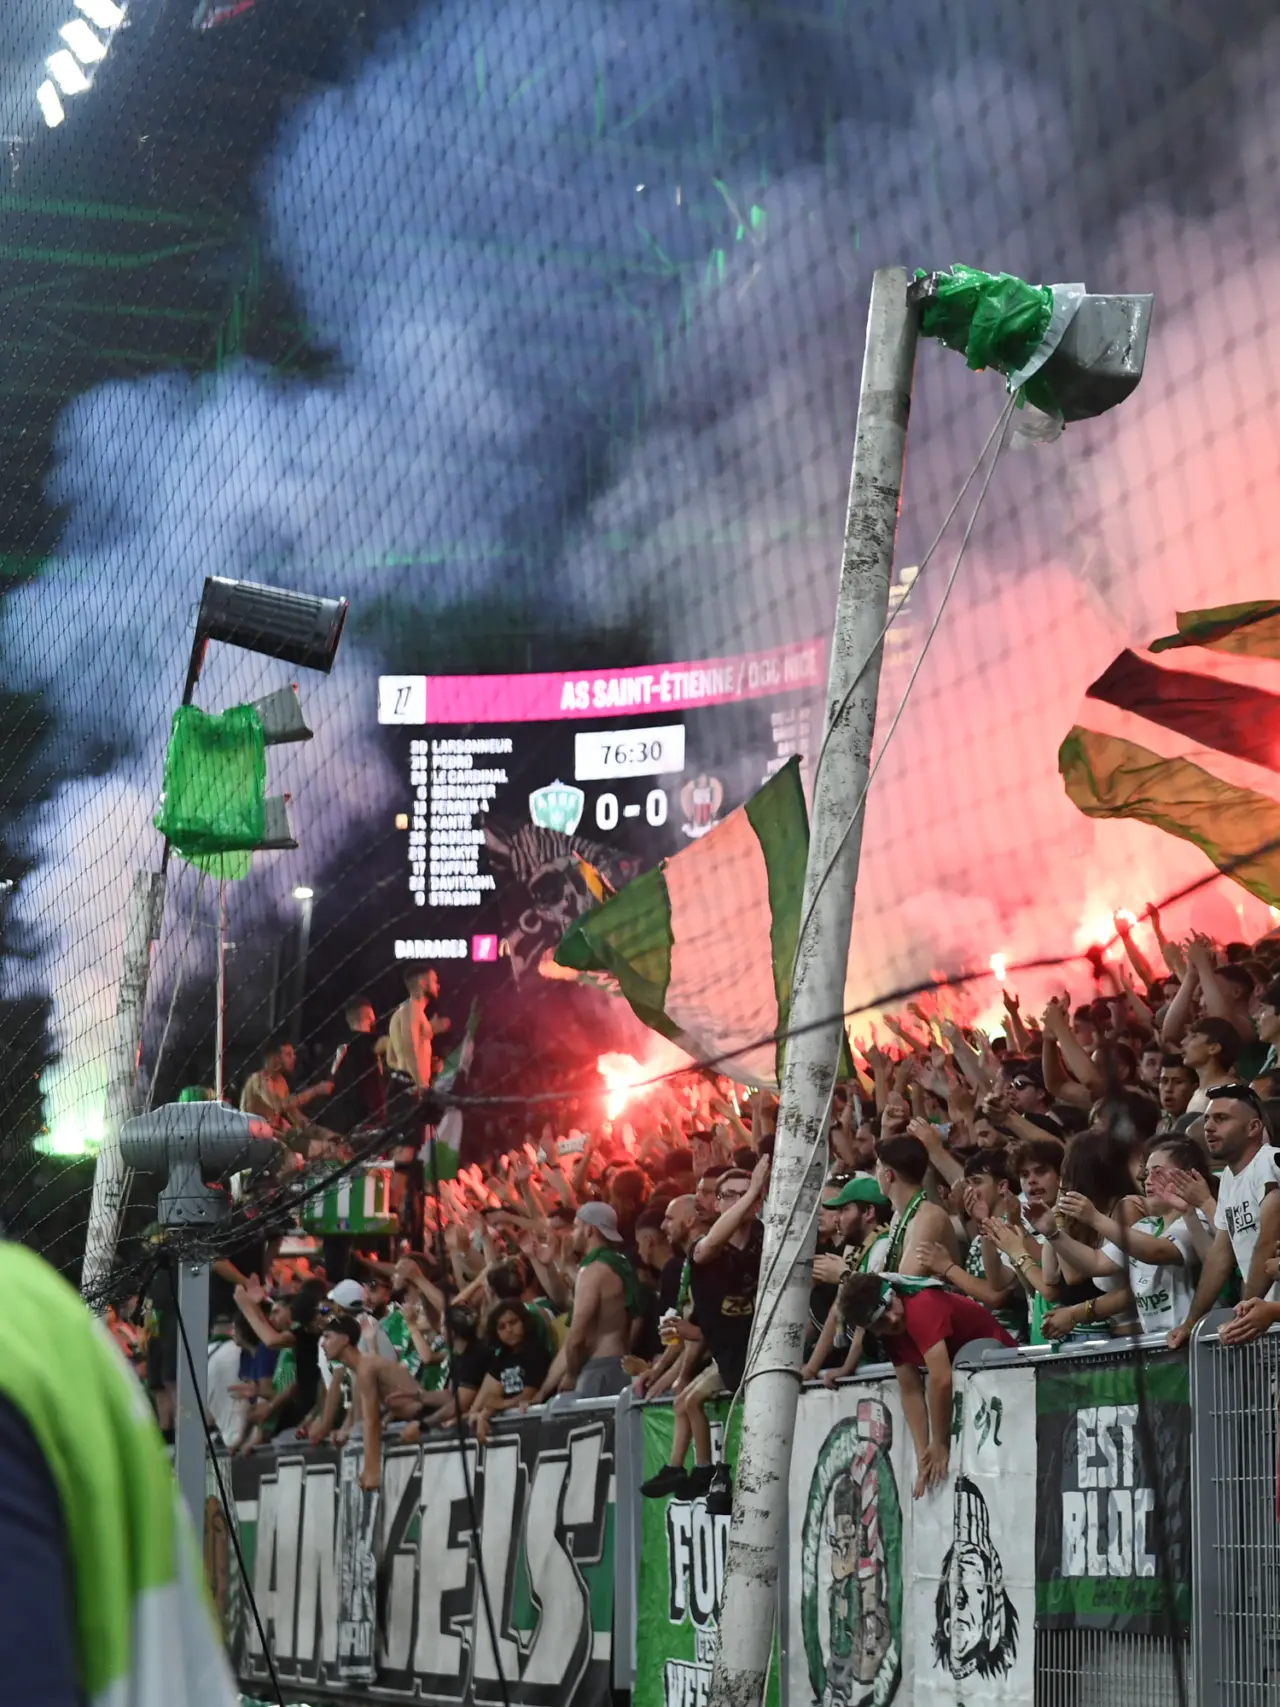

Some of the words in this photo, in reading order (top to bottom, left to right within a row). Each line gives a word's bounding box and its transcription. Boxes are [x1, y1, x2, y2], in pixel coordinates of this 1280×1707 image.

[560, 682, 590, 711] AS
[593, 667, 734, 708] SAINT-ÉTIENNE
[601, 740, 662, 765] 76:30
[1077, 1404, 1139, 1488] EST
[1062, 1487, 1156, 1577] BLOC
